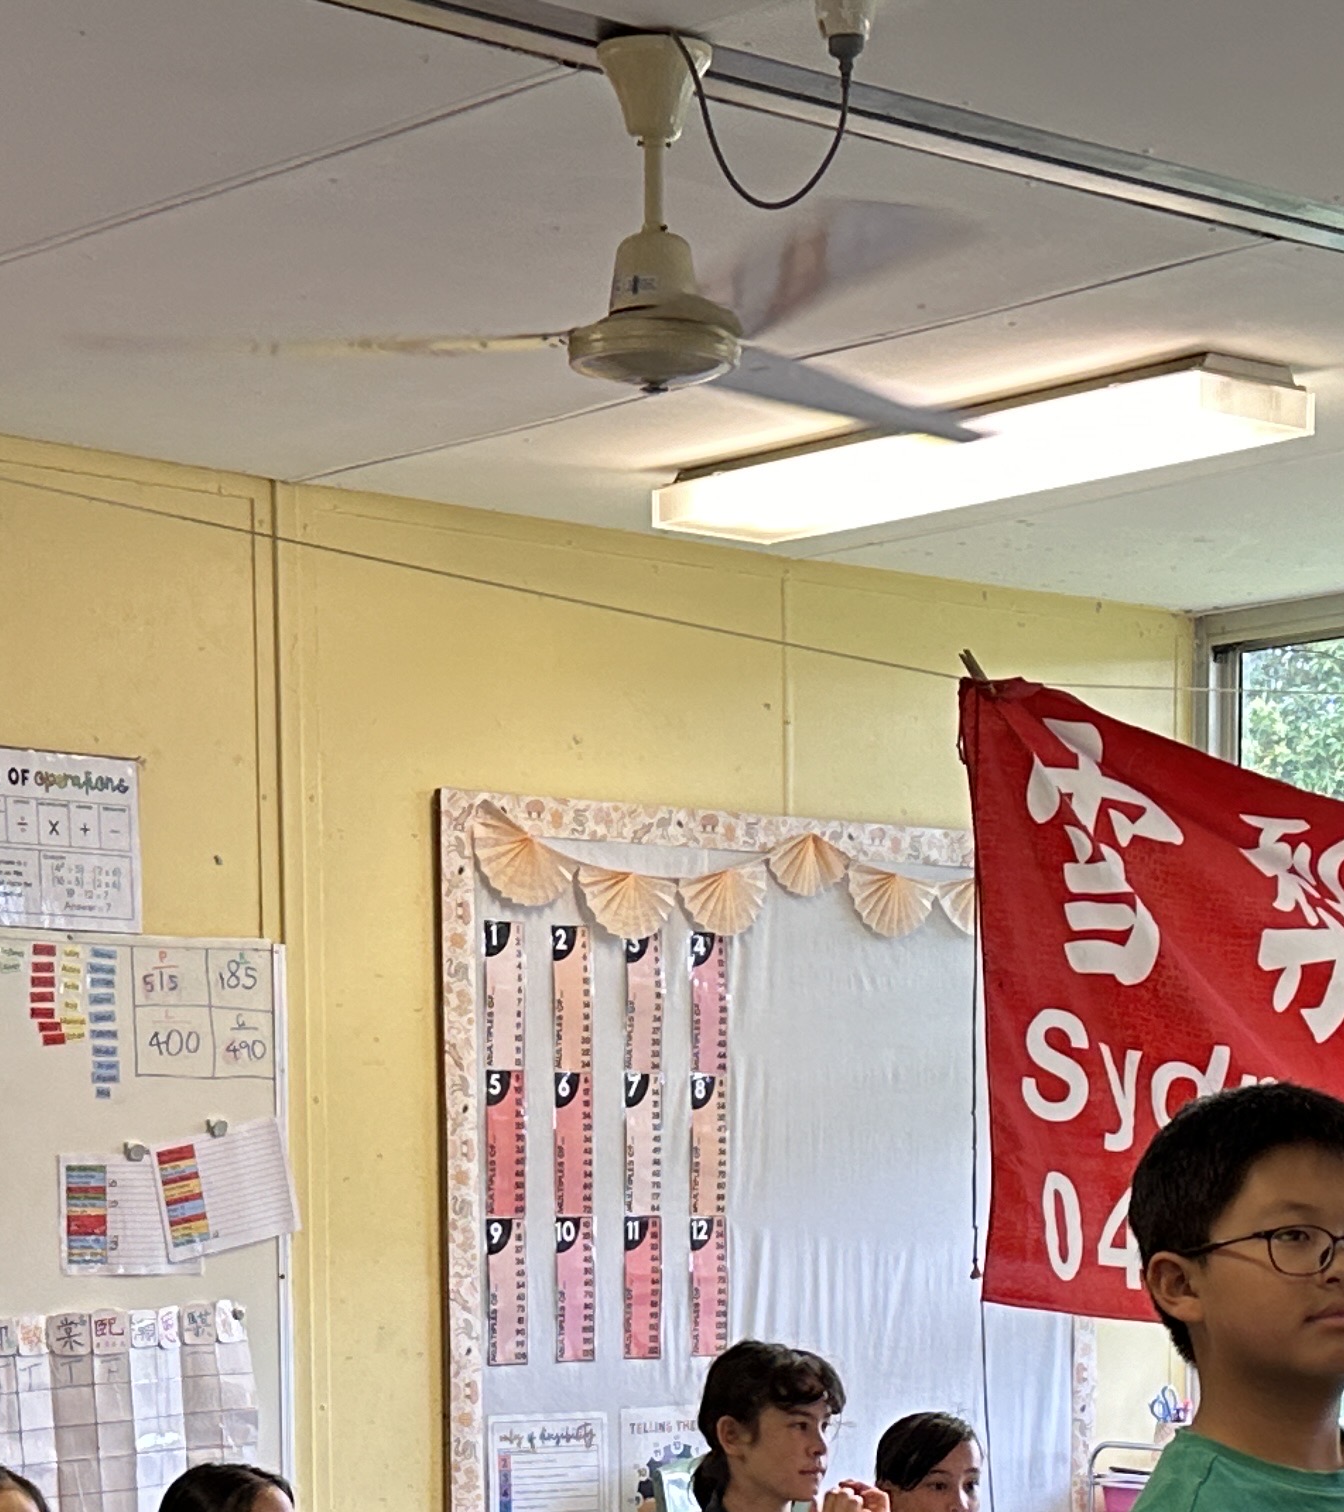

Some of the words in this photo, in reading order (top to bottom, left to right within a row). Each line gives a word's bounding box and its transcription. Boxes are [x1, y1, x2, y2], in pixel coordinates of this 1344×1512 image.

[8, 766, 31, 786] OF
[34, 770, 130, 795] operations
[490, 924, 498, 946] 1
[555, 928, 568, 950] 2
[692, 934, 707, 956] 4
[142, 972, 179, 993] 515
[219, 958, 258, 991] 185
[148, 1029, 201, 1057] 400
[225, 1038, 267, 1062] 490
[488, 1073, 502, 1096] 5
[558, 1071, 571, 1098] 6
[626, 1073, 642, 1098] 7
[694, 1078, 706, 1099] 8
[1022, 1007, 1281, 1153] Syd
[489, 1221, 503, 1244] 9
[555, 1221, 576, 1242] 10
[626, 1220, 640, 1241] 11
[690, 1220, 708, 1241] 12
[629, 1421, 673, 1435] TELLING
